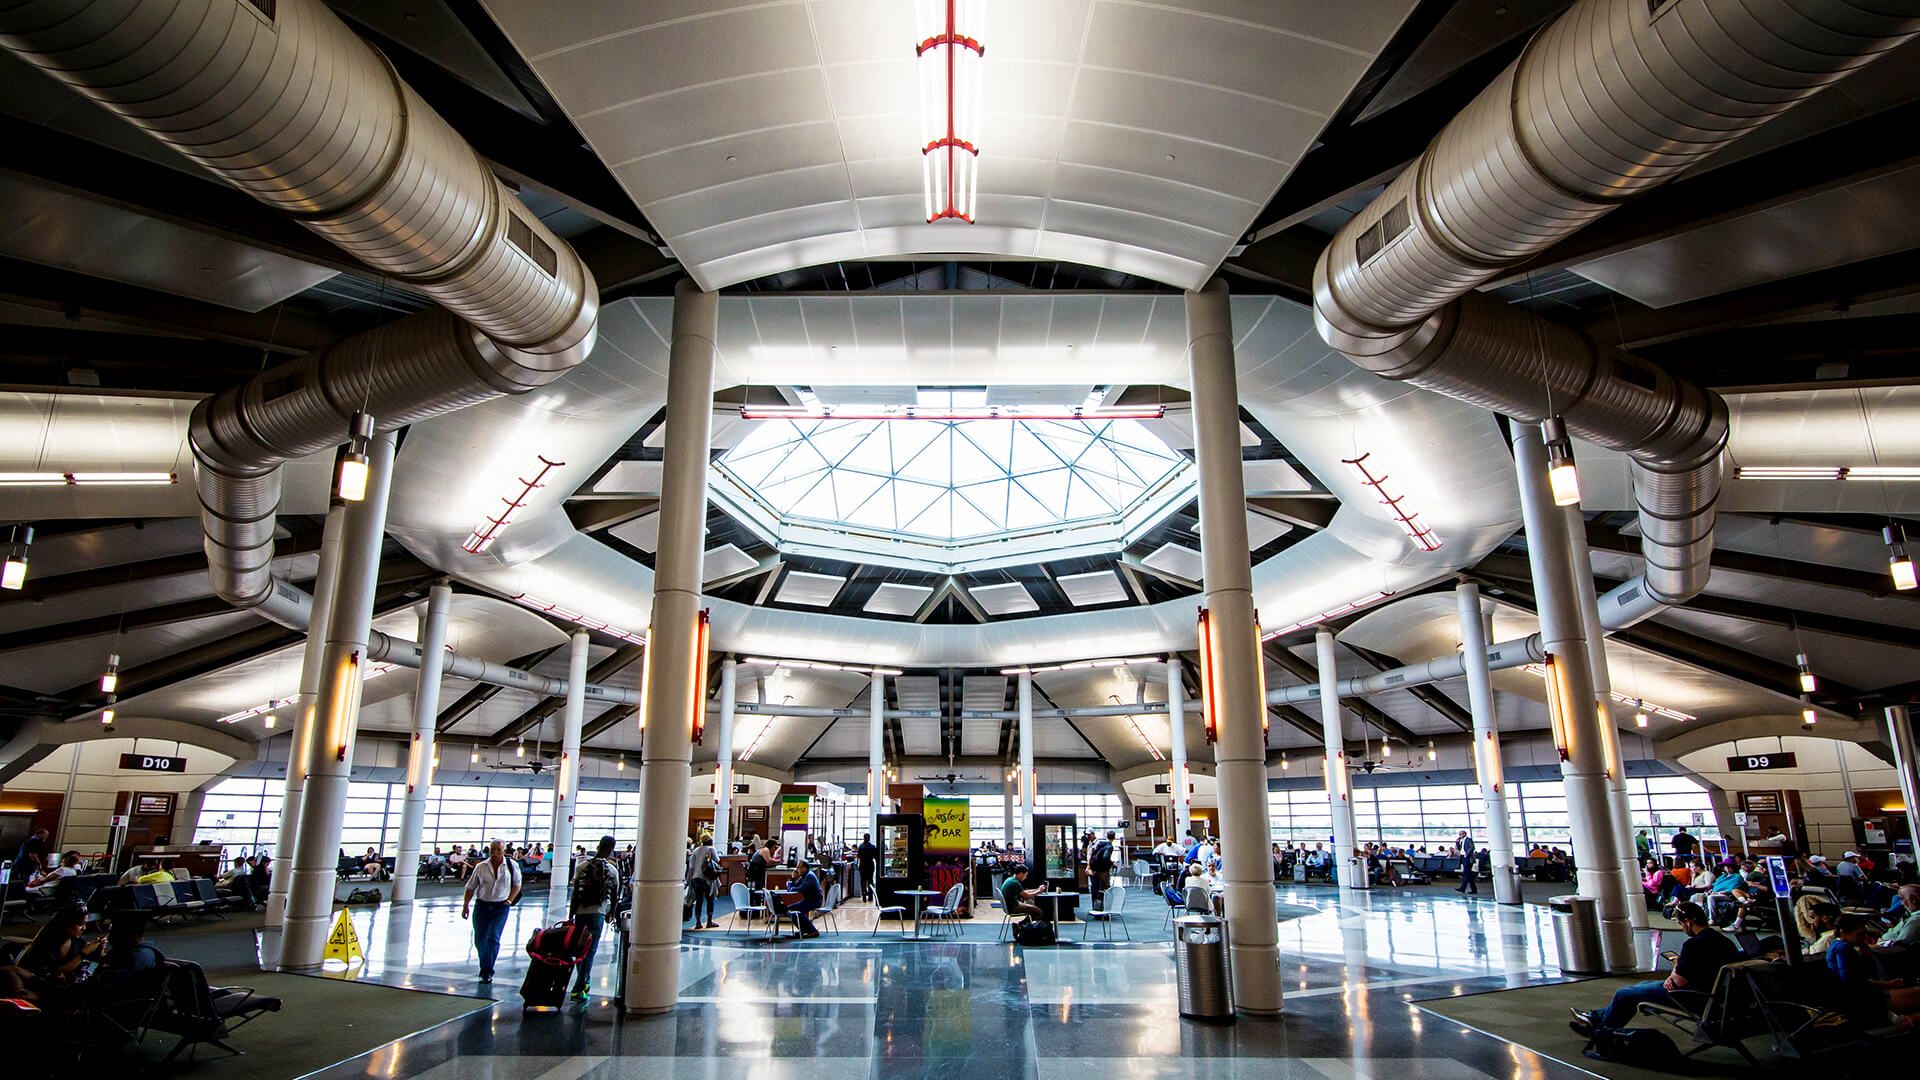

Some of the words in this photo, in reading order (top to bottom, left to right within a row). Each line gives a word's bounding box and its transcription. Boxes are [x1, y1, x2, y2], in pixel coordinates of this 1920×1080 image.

[142, 757, 170, 769] D10
[1747, 756, 1769, 768] D9
[942, 829, 962, 837] BAR
